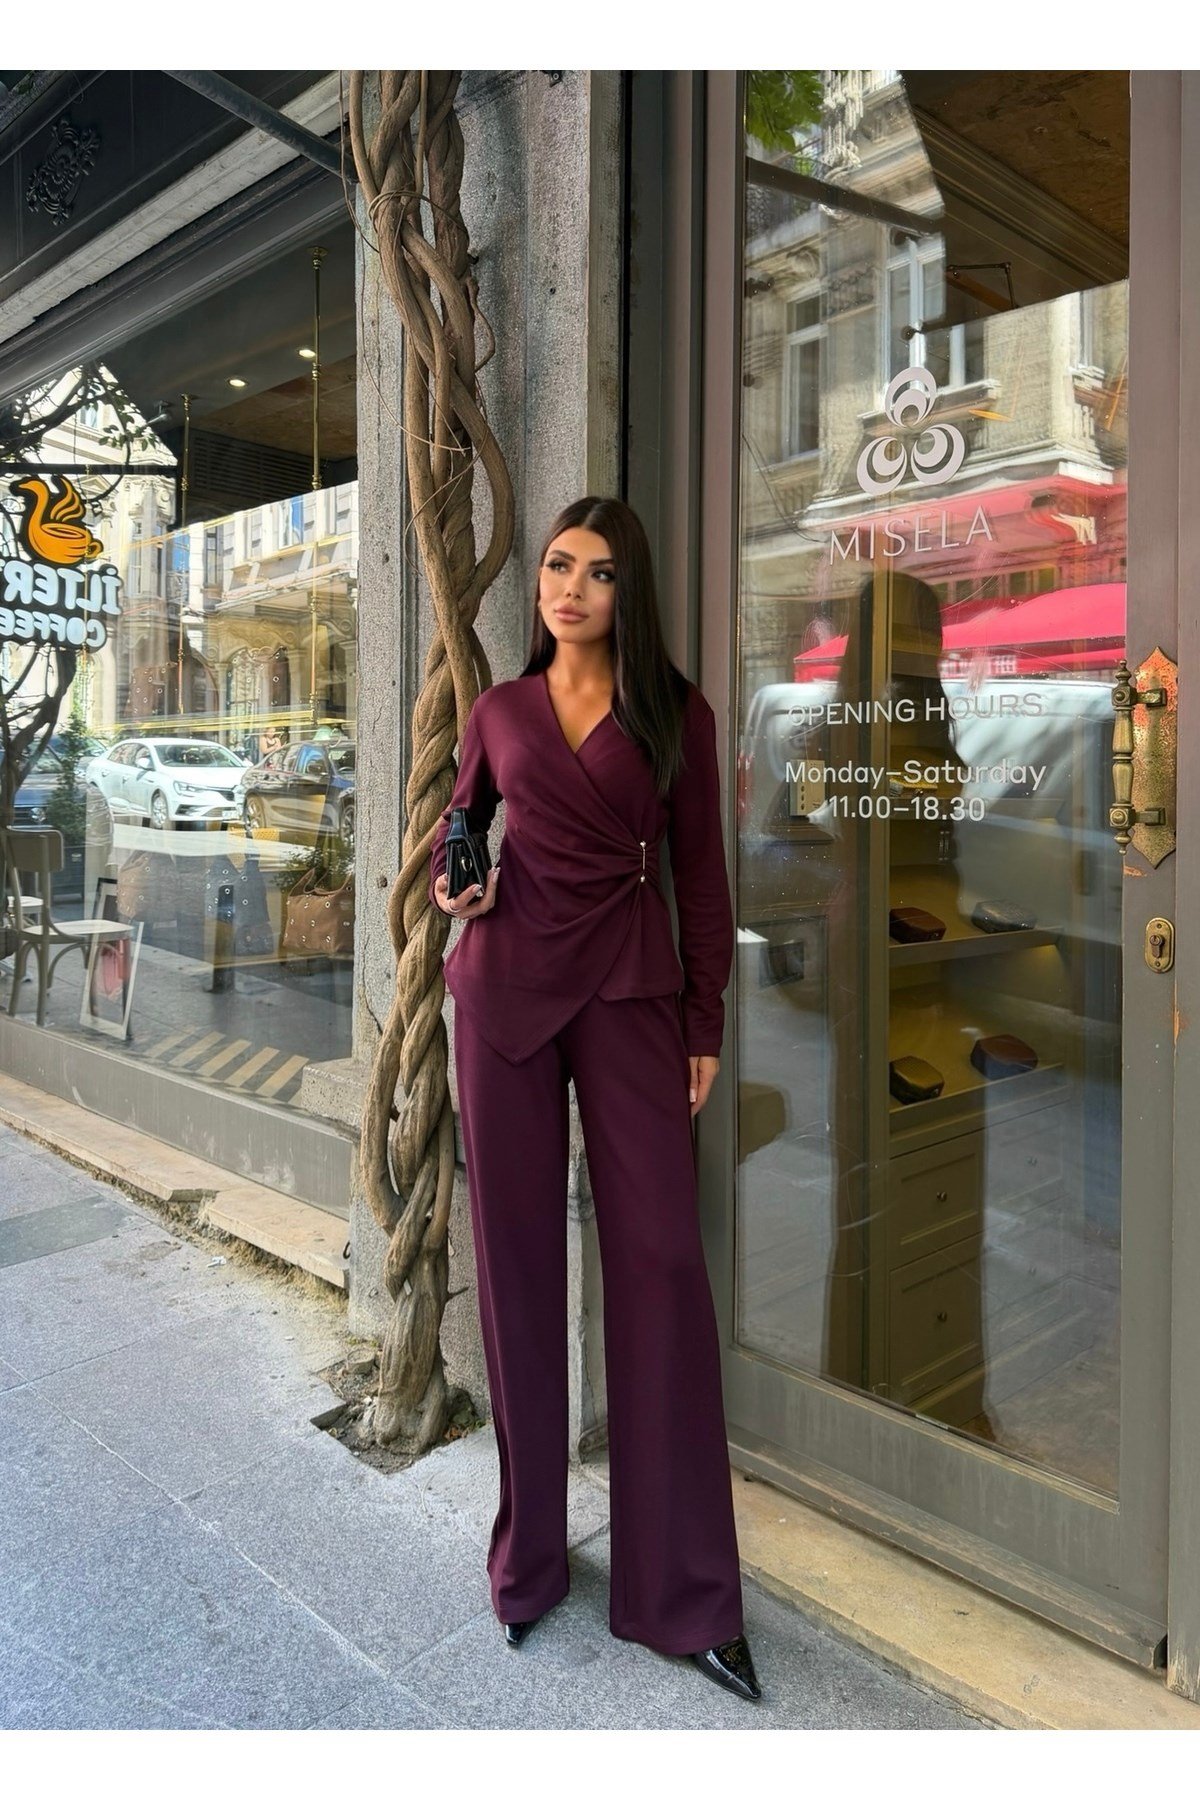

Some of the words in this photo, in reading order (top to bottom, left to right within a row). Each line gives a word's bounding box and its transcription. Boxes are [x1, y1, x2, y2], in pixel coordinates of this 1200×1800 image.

[829, 505, 994, 565] MISELA
[788, 698, 916, 726] OPENING
[925, 692, 1044, 722] HOURS
